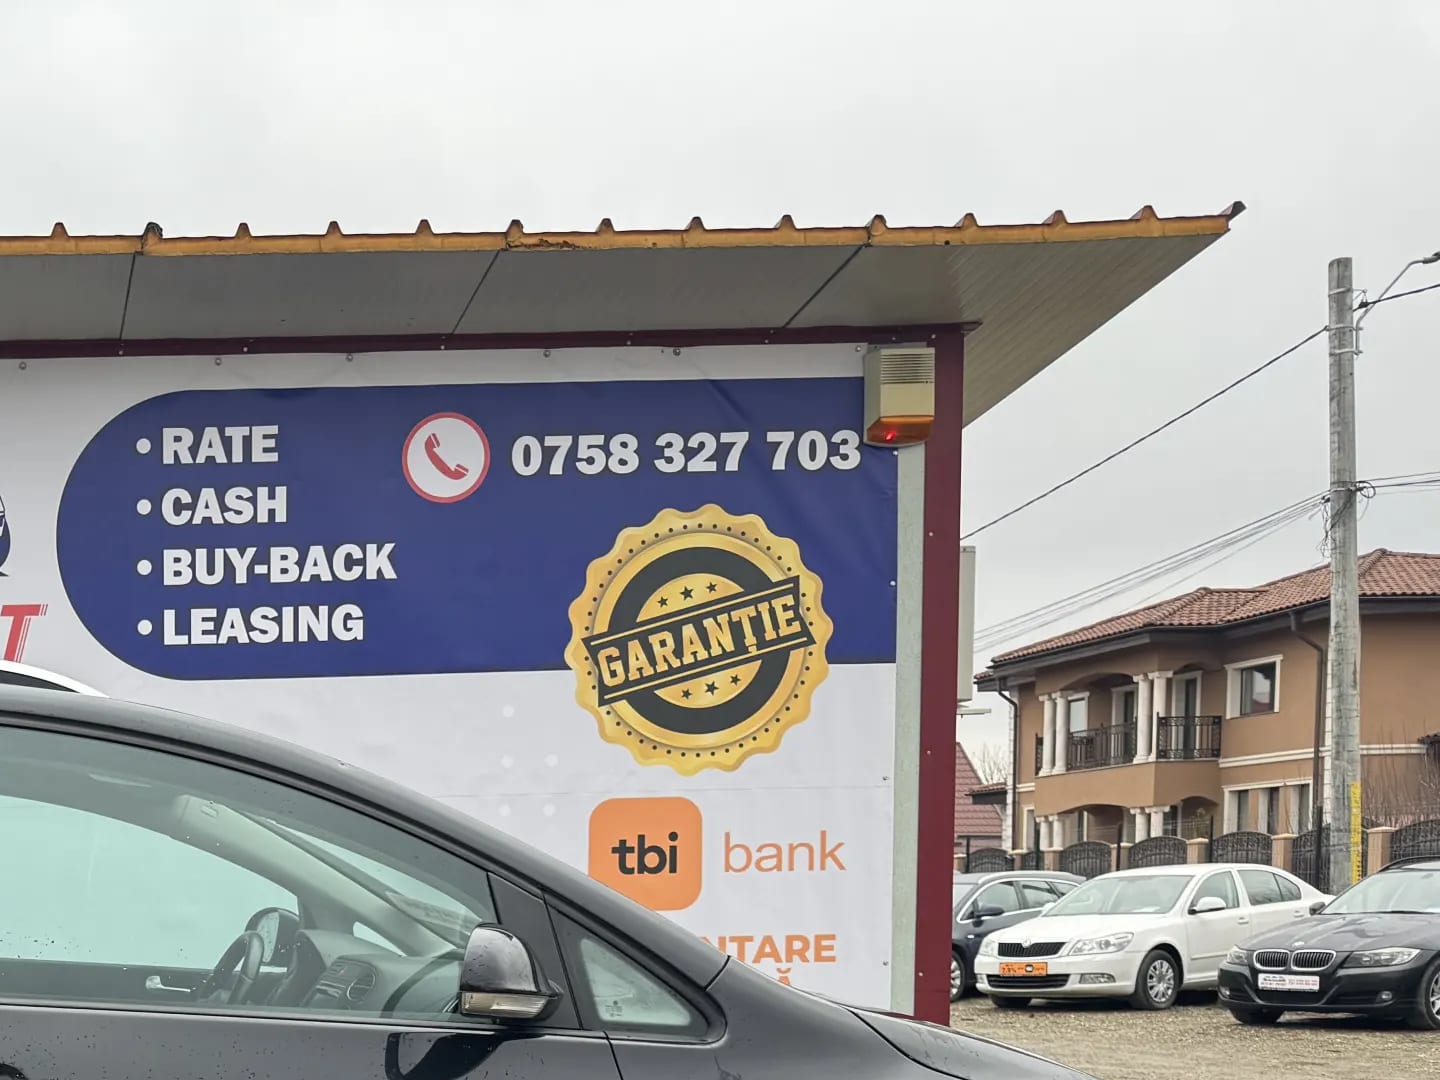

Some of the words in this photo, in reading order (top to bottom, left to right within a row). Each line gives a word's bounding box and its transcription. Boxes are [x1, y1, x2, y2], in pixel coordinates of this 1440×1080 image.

[162, 424, 280, 465] RATE
[510, 433, 640, 476] 0758
[653, 431, 750, 473] 327
[766, 429, 862, 471] 703
[161, 485, 288, 526] CASH
[163, 542, 398, 586] BUY-BACK
[163, 603, 365, 646] LEASING
[611, 831, 679, 875] tbi
[723, 829, 847, 874] bank
